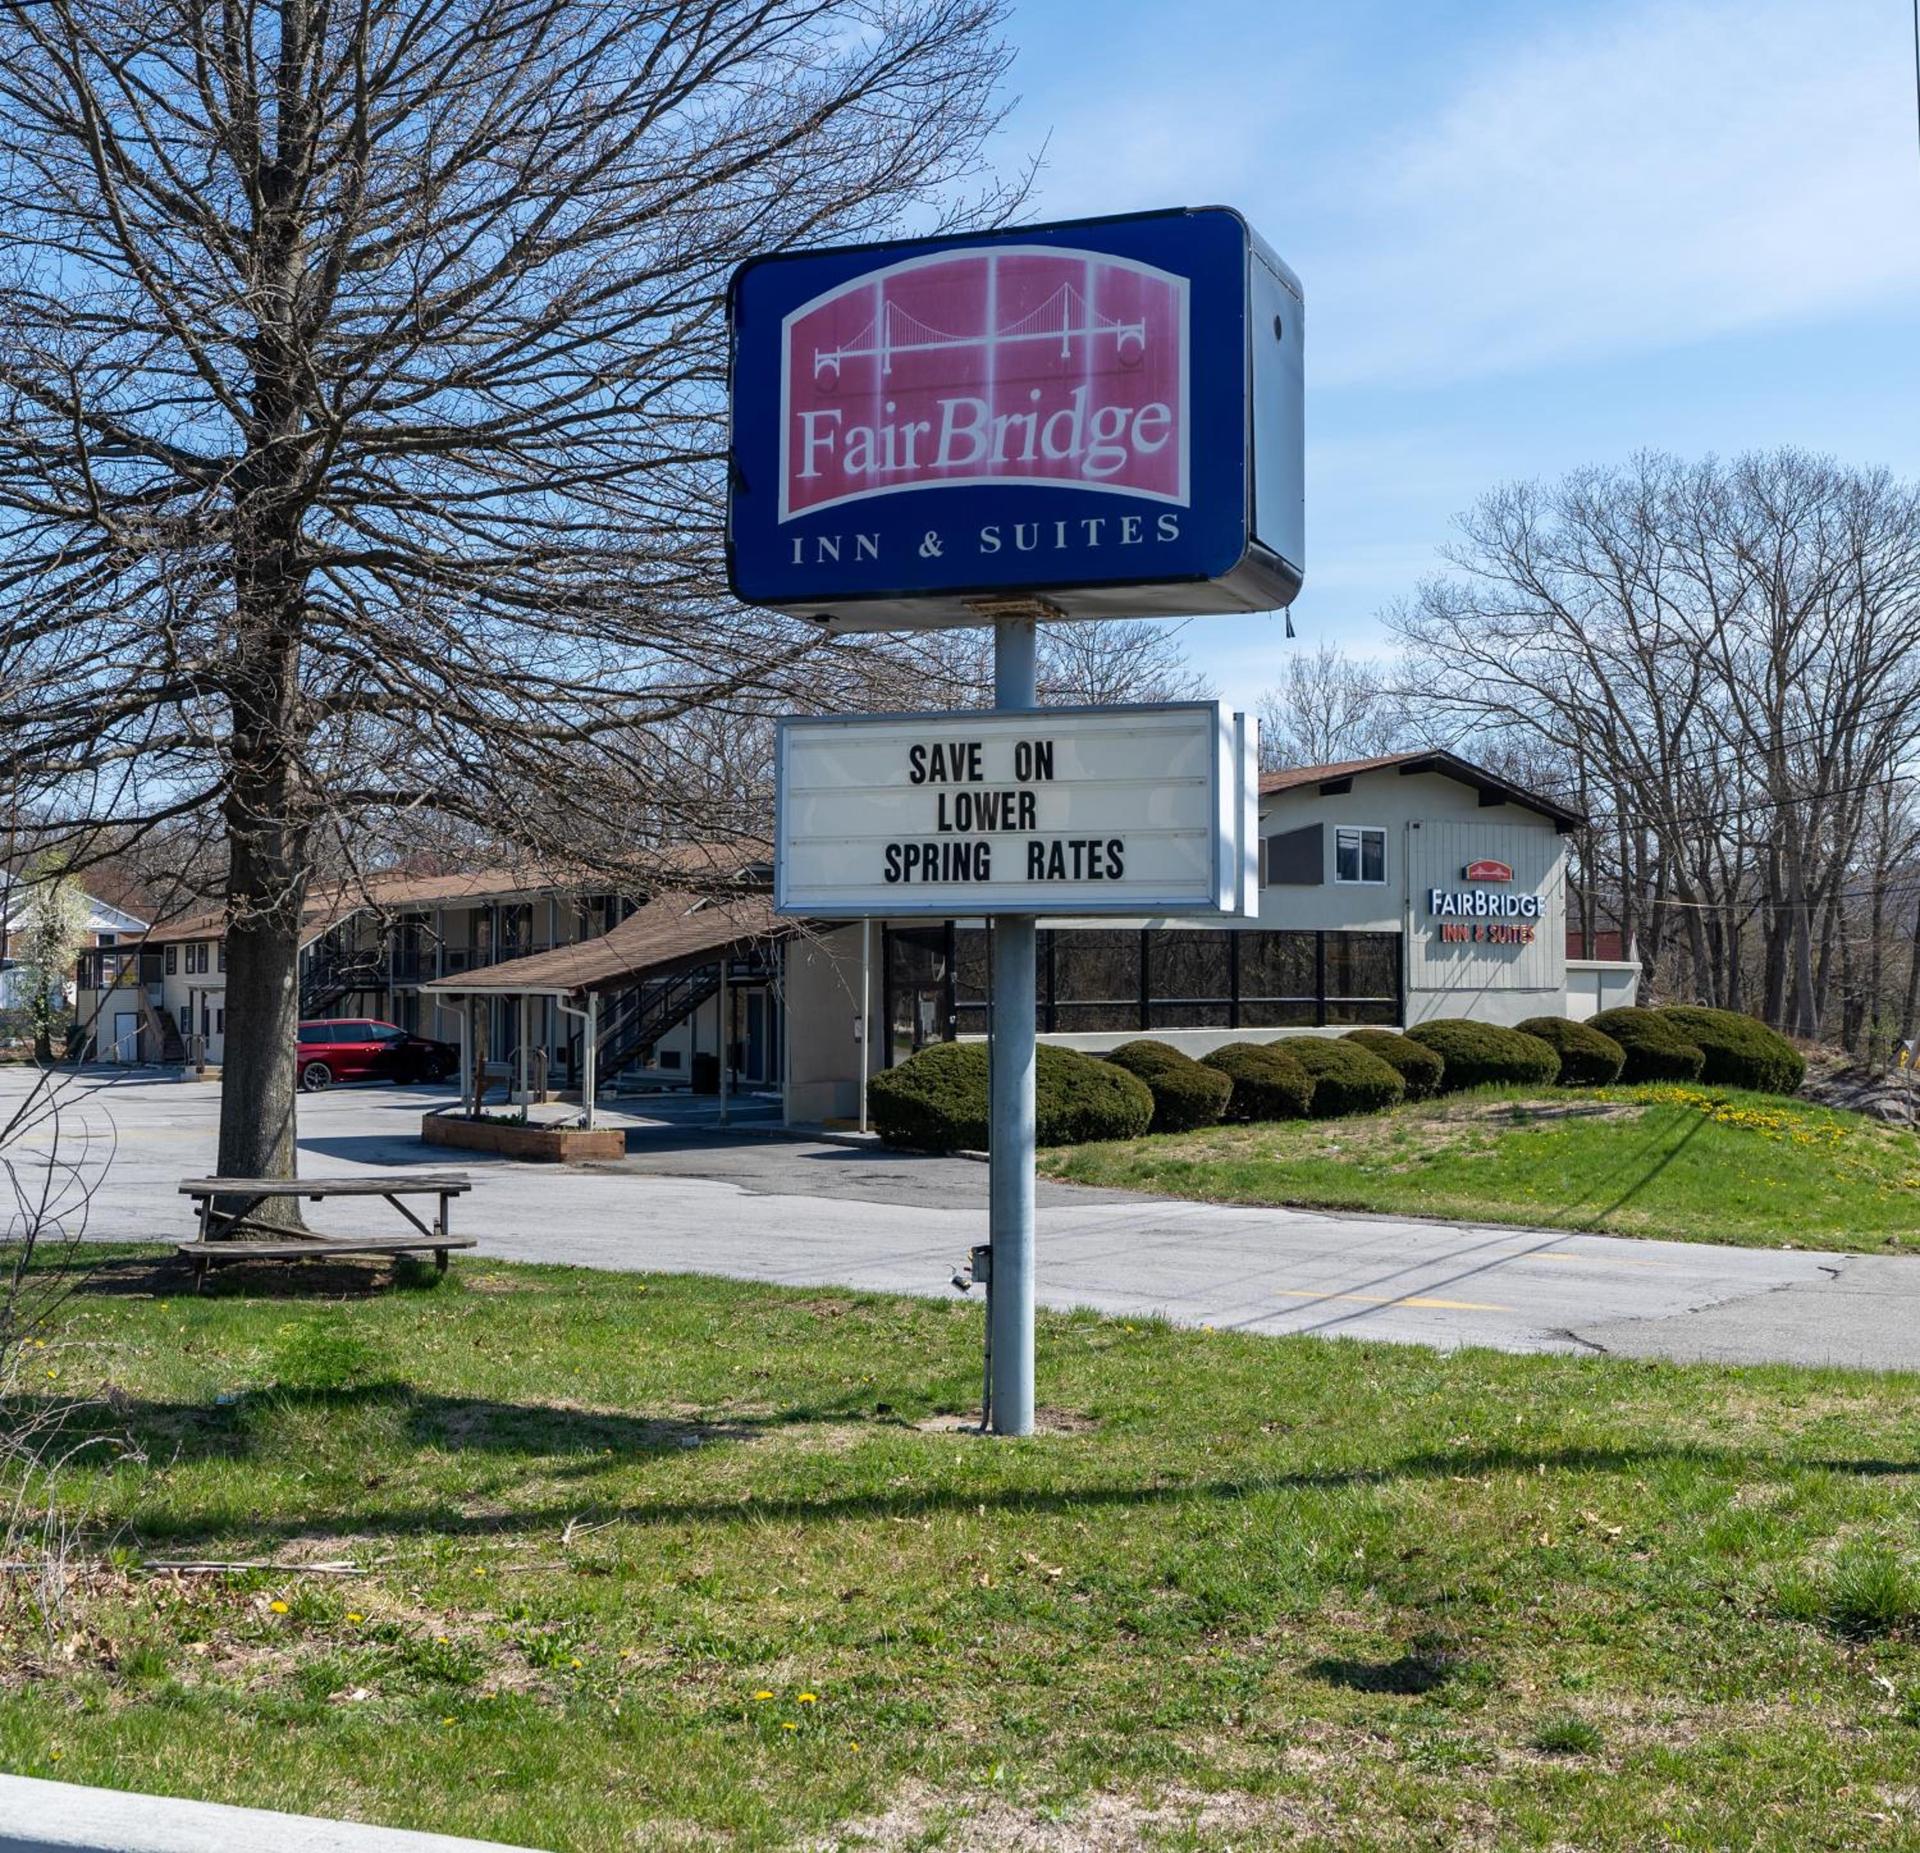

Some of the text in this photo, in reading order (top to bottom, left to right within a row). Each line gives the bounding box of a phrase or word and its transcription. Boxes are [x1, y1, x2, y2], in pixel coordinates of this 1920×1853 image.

[796, 386, 1171, 479] FairBridge
[790, 513, 1181, 565] INN & SUITES
[909, 740, 1054, 784] SAVE ON
[938, 791, 1036, 832] LOWER
[884, 838, 1124, 883] SPRING RATES
[1441, 923, 1536, 944] INN & SUITES
